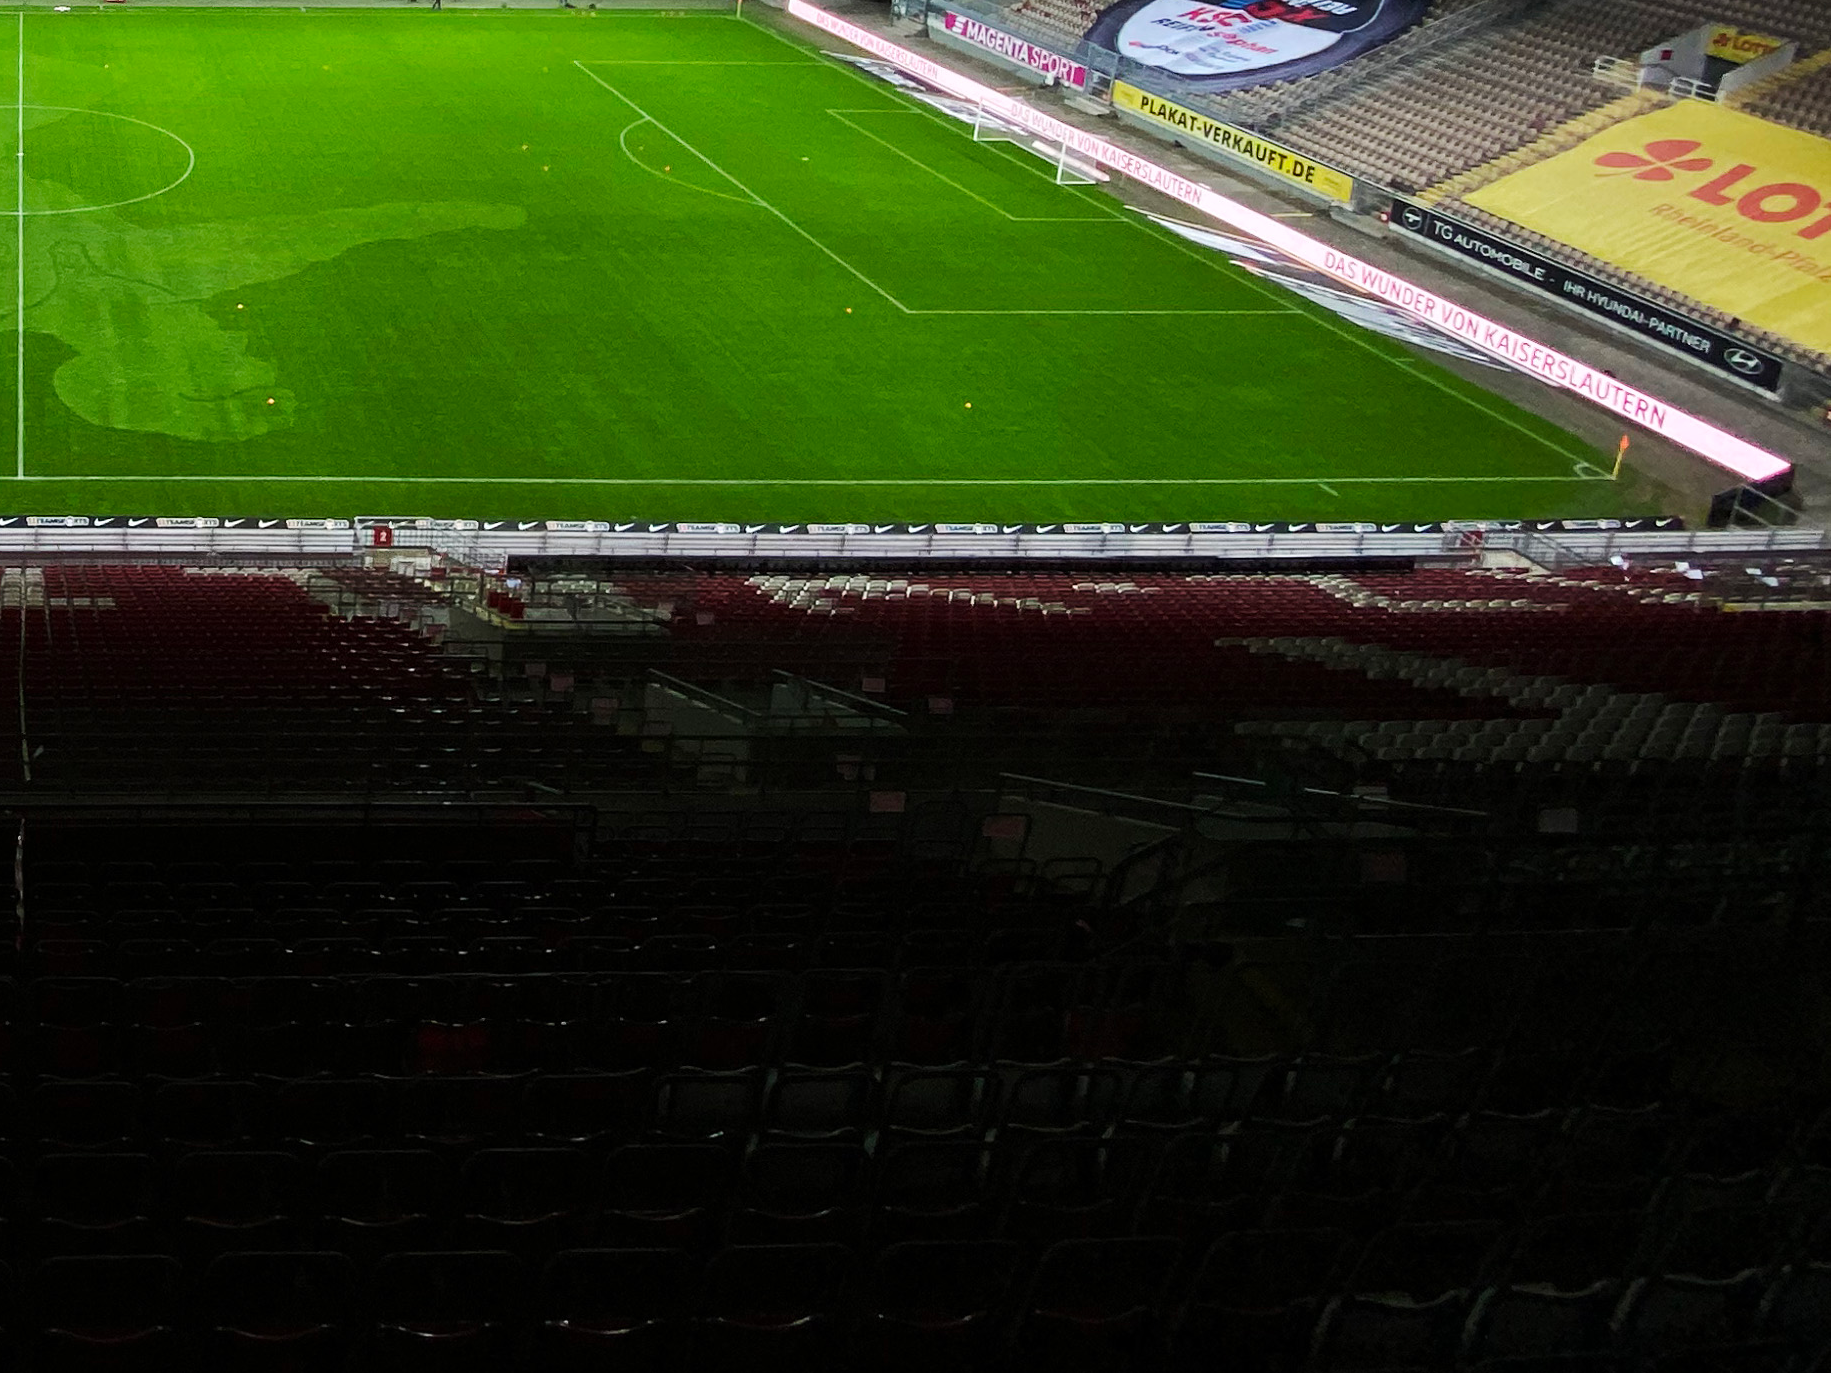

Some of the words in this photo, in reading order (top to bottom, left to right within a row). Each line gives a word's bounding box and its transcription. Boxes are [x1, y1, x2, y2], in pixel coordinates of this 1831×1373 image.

[966, 19, 1029, 64] MAGENTA
[1030, 48, 1076, 83] SPORT
[1011, 103, 1030, 125] DAS
[1031, 113, 1075, 145] WUNDER
[1077, 133, 1100, 156] VON
[1101, 145, 1202, 204] KAISERSLAUTERN
[1140, 95, 1316, 184] PLAKAT-VERKAUFT.DE
[1434, 220, 1453, 241] TG
[1454, 233, 1547, 282] AUTOMOBILE
[1563, 279, 1587, 299] IHR
[1586, 289, 1712, 354] HYUNDAI-PARTNER
[1324, 252, 1358, 279] DAS
[1361, 266, 1436, 318] WUNDER
[1441, 303, 1480, 338] VON
[1484, 328, 1667, 428] KAISERSLAUTERN
